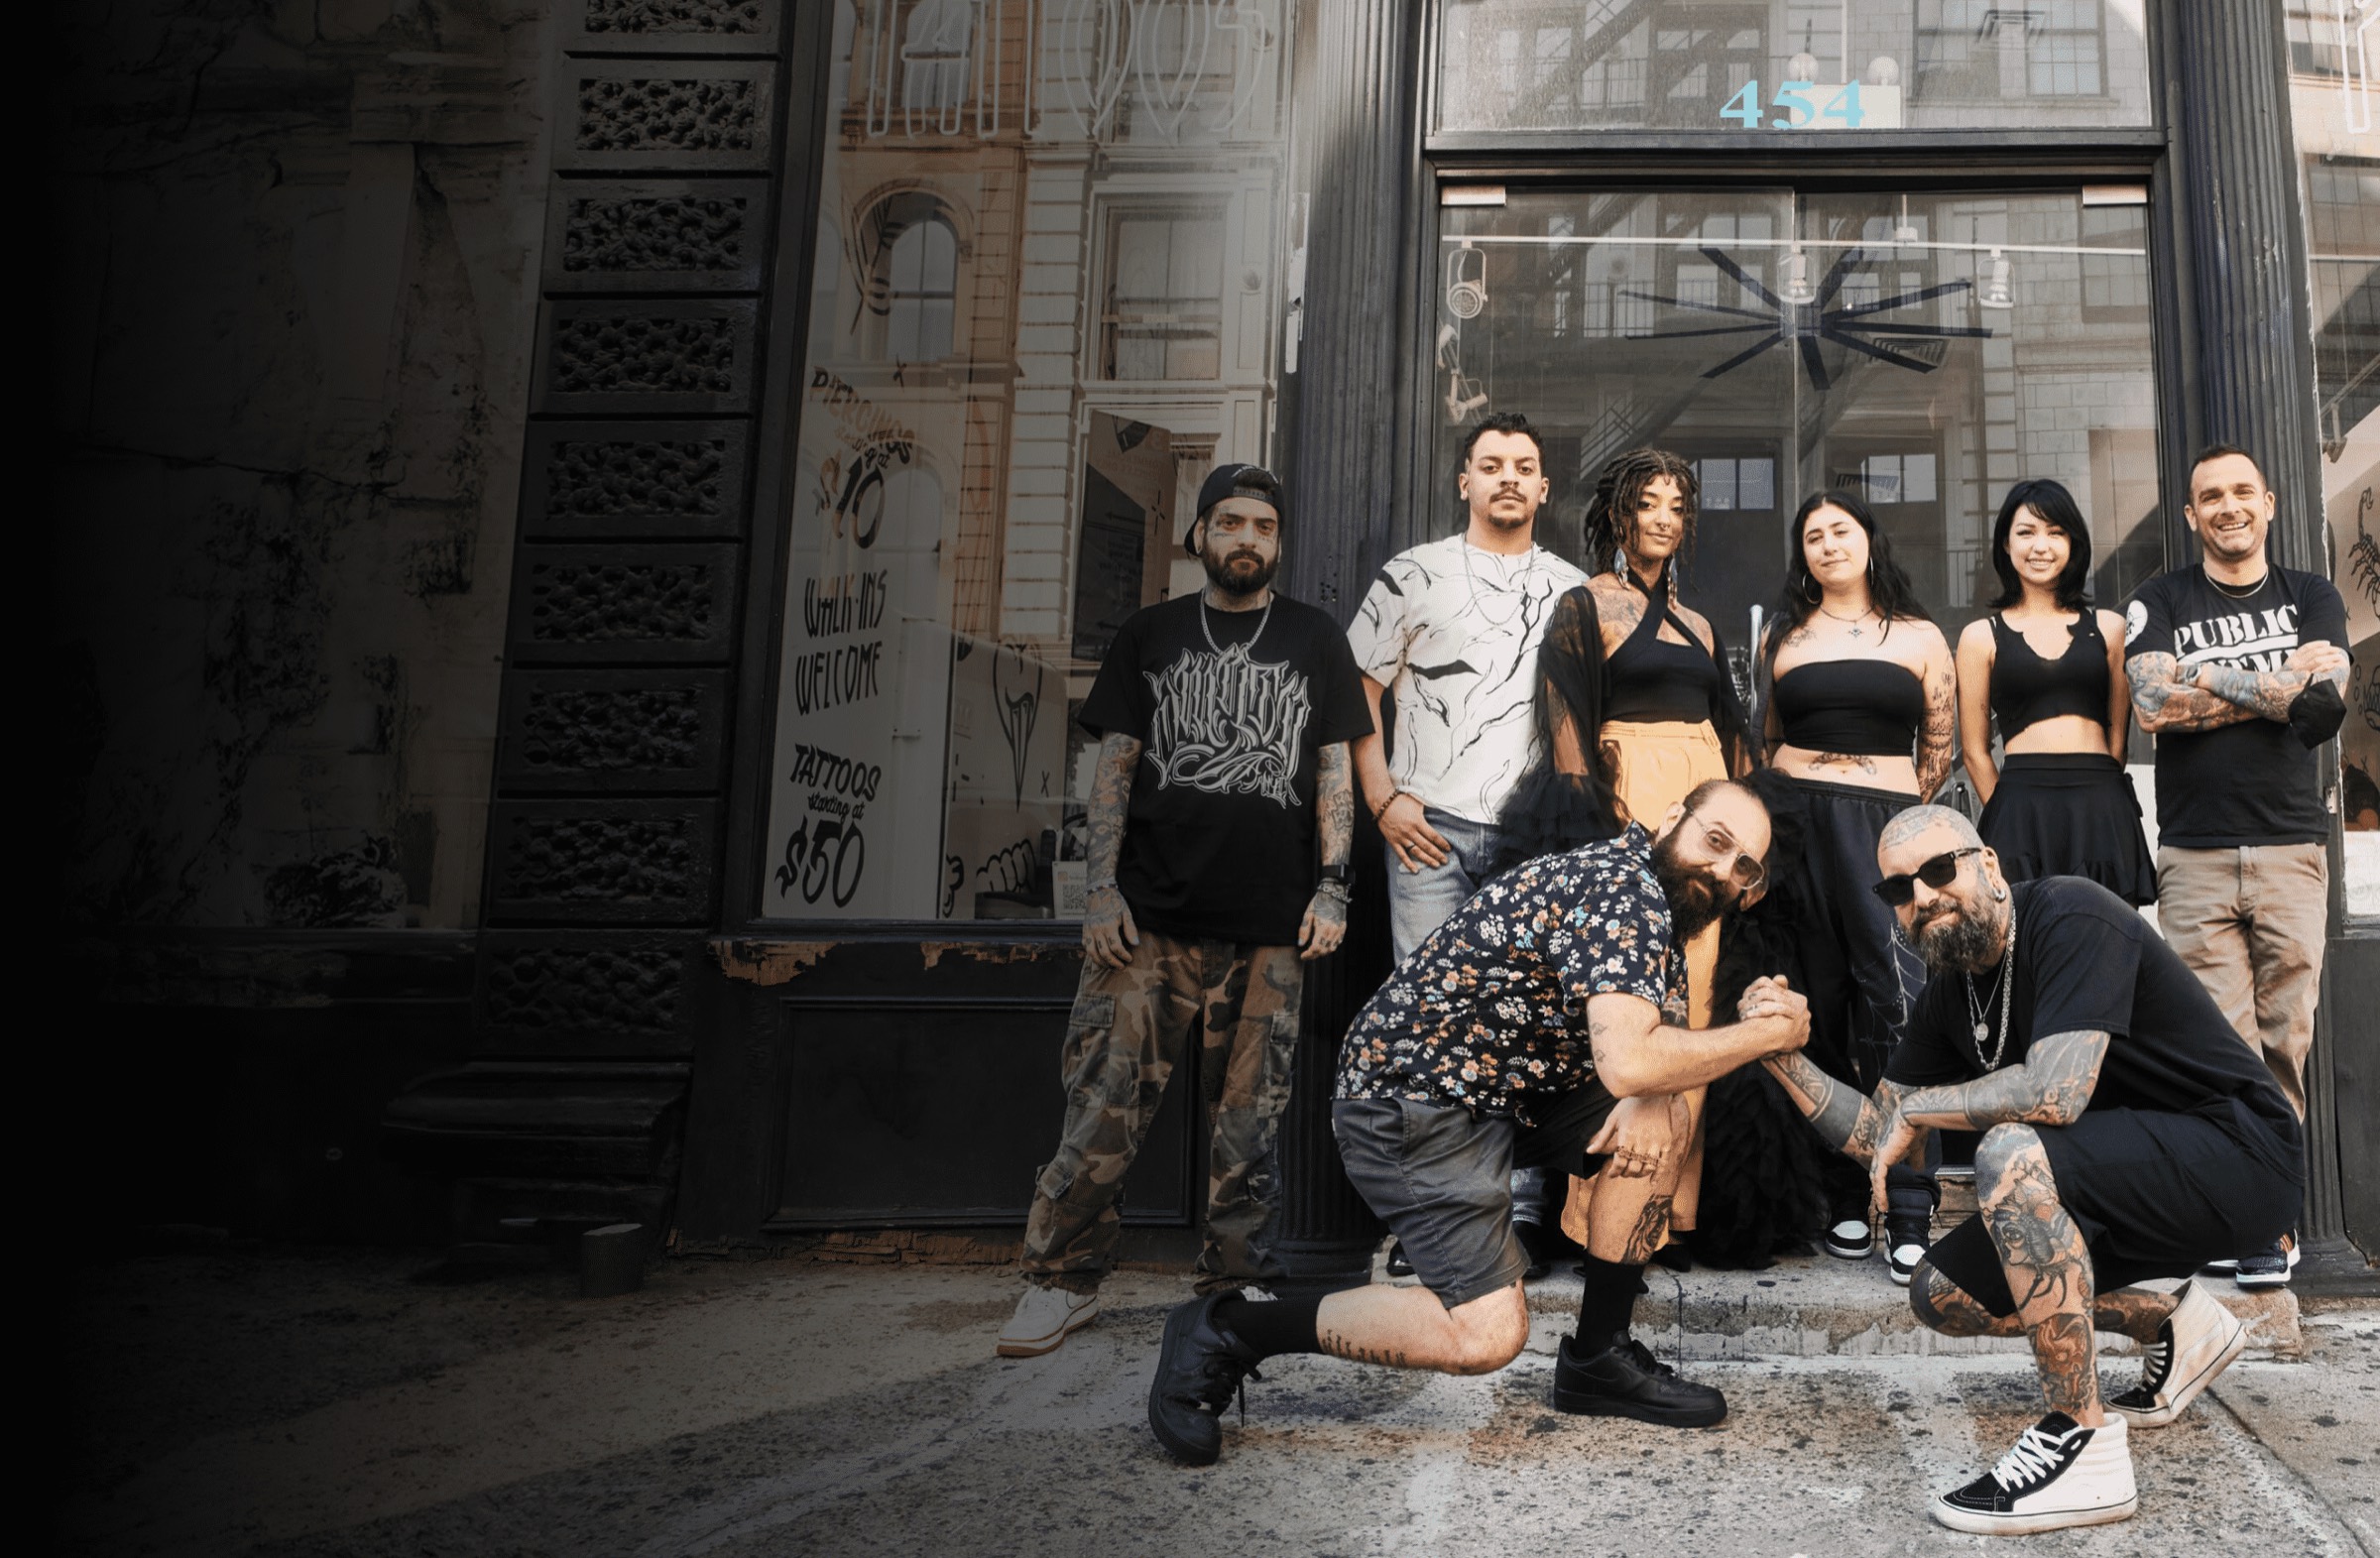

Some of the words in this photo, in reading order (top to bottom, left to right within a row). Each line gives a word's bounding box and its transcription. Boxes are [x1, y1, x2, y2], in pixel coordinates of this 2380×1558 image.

[1719, 79, 1866, 129] 454
[2174, 604, 2299, 659] PUBLIC
[795, 641, 883, 716] WELCOME
[790, 743, 882, 802] TATTOOS
[808, 792, 850, 824] starting
[852, 800, 866, 820] at
[774, 814, 865, 908] $50
